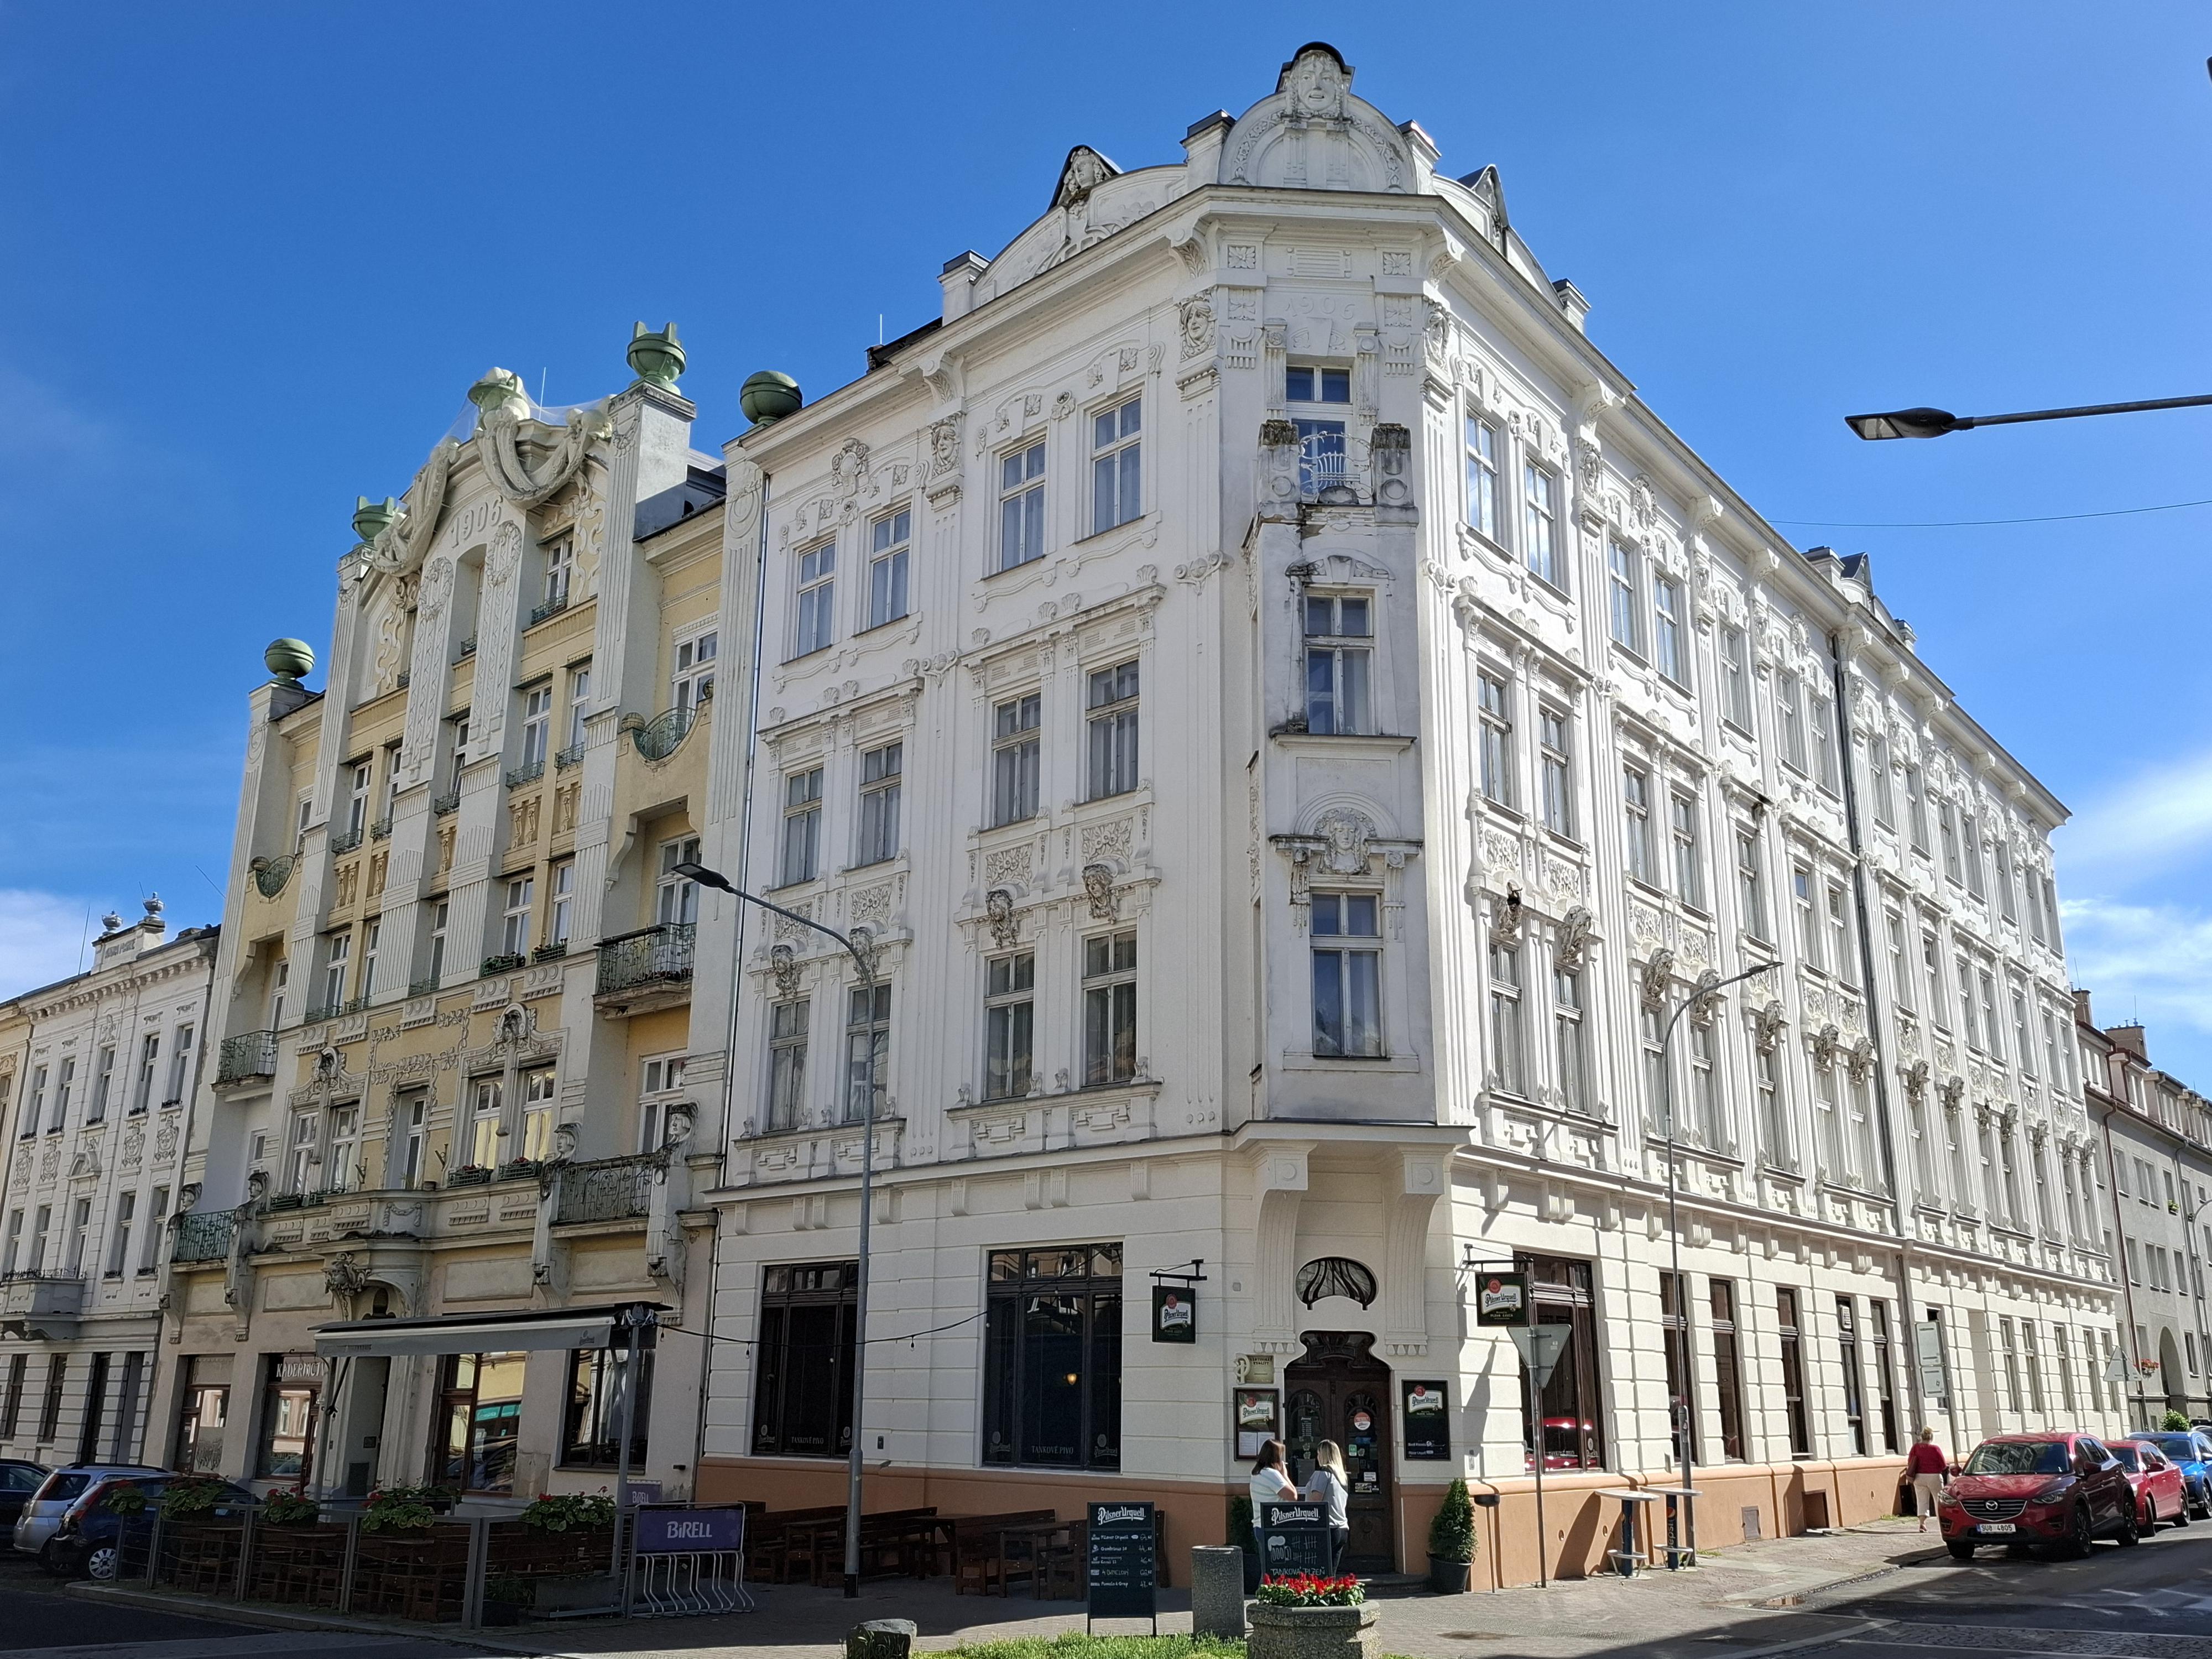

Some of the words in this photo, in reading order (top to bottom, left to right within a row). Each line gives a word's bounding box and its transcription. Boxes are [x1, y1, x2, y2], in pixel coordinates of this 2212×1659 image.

[1285, 296, 1355, 320] 1906
[450, 494, 503, 549] 1906
[1031, 1445, 1058, 1454] TANKOVÉ
[1059, 1446, 1074, 1454] PIVO
[1098, 1506, 1121, 1526] Pilsner
[1121, 1505, 1145, 1521] Urquell
[1271, 1507, 1295, 1526] Pilsner
[1294, 1506, 1319, 1522] Urquell
